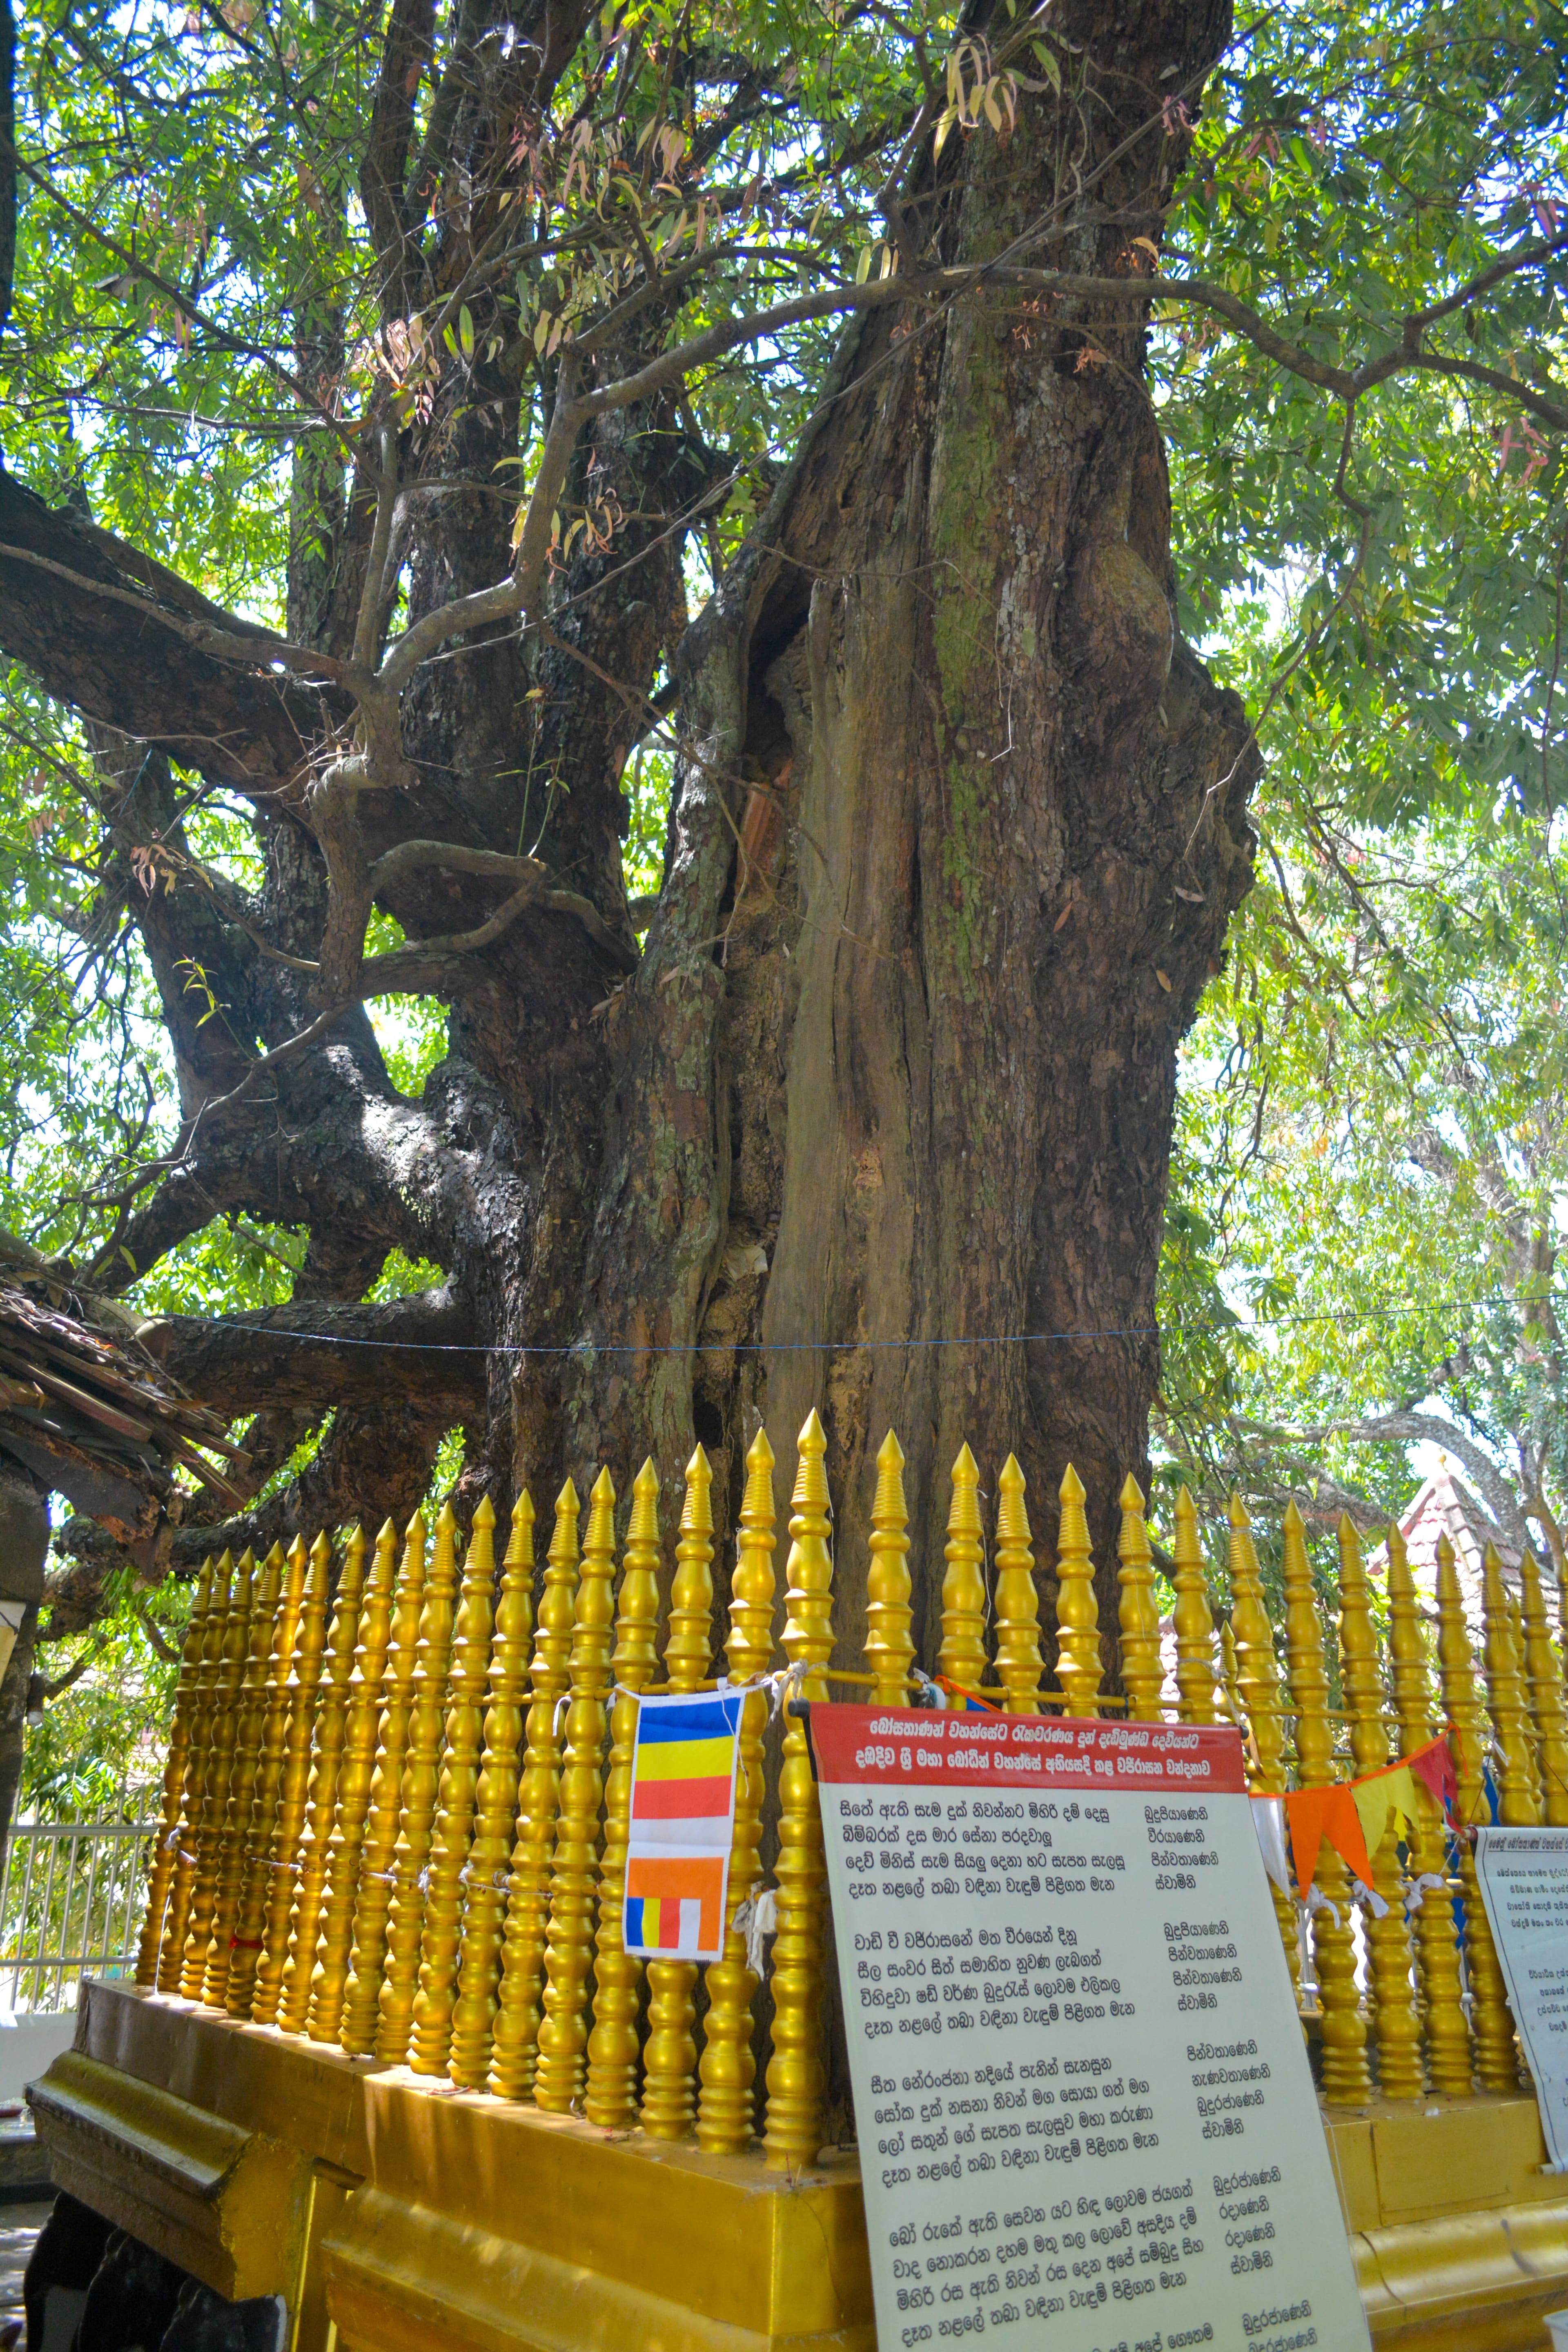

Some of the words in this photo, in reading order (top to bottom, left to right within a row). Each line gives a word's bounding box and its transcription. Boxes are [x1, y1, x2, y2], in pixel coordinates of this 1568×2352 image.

[870, 1717, 945, 1737] බෝසතාණන්
[949, 1721, 1008, 1741] වහන්සේට
[1078, 1729, 1096, 1748] දුන්
[1152, 1731, 1199, 1751] දෙවියන්ට
[855, 1746, 895, 1769] දඹදිව
[916, 1748, 942, 1767] මහා
[994, 1752, 1042, 1771] වහන්සේ
[1045, 1754, 1092, 1776] අභියසදී
[1094, 1760, 1114, 1777] කළ
[1166, 1759, 1210, 1779] වන්දනාව
[840, 1799, 873, 1817] සිතේ
[879, 1800, 909, 1820] ඇති
[914, 1802, 941, 1817] සැම
[947, 1800, 967, 1821] දුක්
[973, 1801, 1024, 1818] නිවන්නට
[1028, 1802, 1058, 1819] මිහිරි
[1063, 1803, 1080, 1822] දම්
[1085, 1808, 1110, 1823] දෙසු
[1144, 1805, 1208, 1824] බුදුපියාණෙනි
[842, 1824, 900, 1843] බිම්බරක්
[906, 1830, 927, 1846] දස
[932, 1826, 957, 1843] මාර
[962, 1825, 997, 1843] සේනා
[1002, 1827, 1052, 1847] පරදවාලූ
[1147, 1827, 1205, 1843] වීරයාණෙනි
[846, 1851, 874, 1873] දෙව්
[880, 1851, 915, 1869] මිනිස්
[921, 1852, 949, 1869] සැම
[954, 1852, 987, 1872] සියලු
[991, 1855, 1022, 1871] දෙනා
[1027, 1852, 1047, 1867] හට
[1051, 1855, 1087, 1867] සැපත
[1091, 1855, 1126, 1871] සැලසූ
[1151, 1850, 1219, 1866] පින්වතාණෙනි
[849, 1883, 877, 1900] දෑත
[882, 1877, 924, 1898] නළලේ
[931, 1878, 960, 1895] තබා
[964, 1878, 1001, 1897] වඳිනා
[1006, 1875, 1040, 1896] වැඳුම්
[1045, 1876, 1086, 1895] පිළිගත
[1090, 1876, 1115, 1891] මැන
[1155, 1873, 1196, 1890] ස්වාමිනි
[854, 1931, 882, 1951] වාඩි
[887, 1931, 899, 1949] වී
[904, 1928, 973, 1949] වජිරාසනේ
[978, 1929, 1001, 1946] මත
[1004, 1925, 1053, 1944] වීරයෙන්
[1057, 1927, 1078, 1946] දිනූ
[1163, 1920, 1229, 1941] බුදුපියාණෙනි
[857, 1961, 881, 1982] සීල
[887, 1959, 926, 1977] සංවර
[931, 1956, 954, 1975] සිත්
[960, 1955, 1011, 1973] සමාහිත
[1016, 1953, 1050, 1974] නුවණ
[1056, 1948, 1101, 1971] ලැබගත්
[1168, 1943, 1237, 1962] පින්වතාණෙනි
[860, 1987, 911, 2009] විහිදුවා
[943, 1984, 978, 2002] වර්ණ
[983, 1978, 1029, 2003] බුදුරැස්
[1034, 1978, 1076, 1998] ලොවම
[1080, 1976, 1121, 1995] එලිකල
[1172, 1967, 1242, 1986] පින්වතාණෙනි
[864, 2021, 893, 2040] දෑත
[899, 2011, 942, 2036] නළලේ
[947, 2011, 974, 2029] තබා
[980, 2009, 1018, 2029] වඳිනා
[1023, 2003, 1059, 2026] වැඳුම්
[1064, 2003, 1105, 2022] පිළිගත
[1110, 2000, 1135, 2017] මැන
[1177, 1992, 1218, 2011] ස්වාමිනි
[871, 2075, 896, 2094] සීත
[902, 2069, 969, 2091] නේරංජනා
[975, 2061, 1014, 2086] නදියේ
[1020, 2057, 1059, 2079] පැනින්
[1063, 2057, 1112, 2076] සැනසුන
[1187, 2039, 1258, 2061] පින්වතාණෙනි
[874, 2101, 914, 2124] සෝක
[920, 2097, 942, 2123] දුක්
[948, 2098, 988, 2115] නසනා
[993, 2088, 1027, 2110] නිවන්
[1032, 2088, 1055, 2105] මග
[1060, 2086, 1098, 2103] සොයා
[1102, 2077, 1124, 2098] ගත්
[1129, 2078, 1149, 2094] මග
[1192, 2063, 1271, 2087] නැණවතාණෙනි
[878, 2131, 904, 2156] ලෝ
[911, 2126, 948, 2152] සතුන්
[954, 2123, 976, 2144] ගේ
[980, 2123, 1021, 2141] සැපත
[1026, 2113, 1074, 2136] සැලසුව
[1079, 2111, 1105, 2128] මහා
[1109, 2105, 1153, 2124] කරුණා
[1197, 2089, 1265, 2117] බුදුරජාණෙනි
[882, 2167, 911, 2189] දෑත
[917, 2154, 962, 2181] නළලේ
[967, 2152, 996, 2173] තබා
[1001, 2148, 1039, 2169] වඳිනා
[1044, 2138, 1081, 2163] වැඳුම්
[1086, 2137, 1128, 2157] පිළිගත
[1133, 2132, 1159, 2149] මැන
[1202, 2118, 1244, 2139] ස්වාමිනි
[889, 2222, 916, 2247] බෝ
[922, 2214, 962, 2241] රුකේ
[969, 2211, 998, 2237] ඇති
[1004, 2206, 1046, 2228] සෙවන
[1051, 2200, 1072, 2220] යට
[1077, 2196, 1101, 2216] හිඳ
[1105, 2188, 1147, 2213] ලොවම
[1152, 2178, 1193, 2203] ජයගත්
[1213, 2165, 1281, 2196] බුදුරජාණෙනි
[893, 2259, 922, 2280] වාද
[927, 2246, 990, 2273] නොකරන
[996, 2237, 1028, 2264] දහම
[1034, 2235, 1059, 2254] මතු
[1062, 2232, 1086, 2250] කල
[1090, 2217, 1132, 2245] ලොවේ
[1179, 2206, 1197, 2230] දම්
[1219, 2195, 1270, 2221] රදාණෙනි
[896, 2286, 935, 2311] මිහිරි
[941, 2283, 964, 2303] රස
[970, 2273, 1000, 2301] ඇති
[1006, 2264, 1040, 2290] නිවන්
[1046, 2263, 1067, 2282] රස
[1072, 2259, 1101, 2278] දෙන
[1107, 2246, 1135, 2274] අපේ
[1139, 2242, 1180, 2264] සම්බුදු
[1225, 2222, 1275, 2249] රදාණෙනි
[902, 2325, 932, 2348] දෑත
[938, 2306, 985, 2337] නළලේ
[990, 2303, 1020, 2325] තබා
[1025, 2296, 1064, 2319] වඳිනා
[1069, 2282, 1107, 2309] වැඳුම්
[1111, 2278, 1155, 2301] පිළිගත
[1160, 2272, 1187, 2290] මැන
[1230, 2250, 1273, 2275] ස්වාමිනි
[1242, 2299, 1312, 2336] බුදුරජාණෙනි
